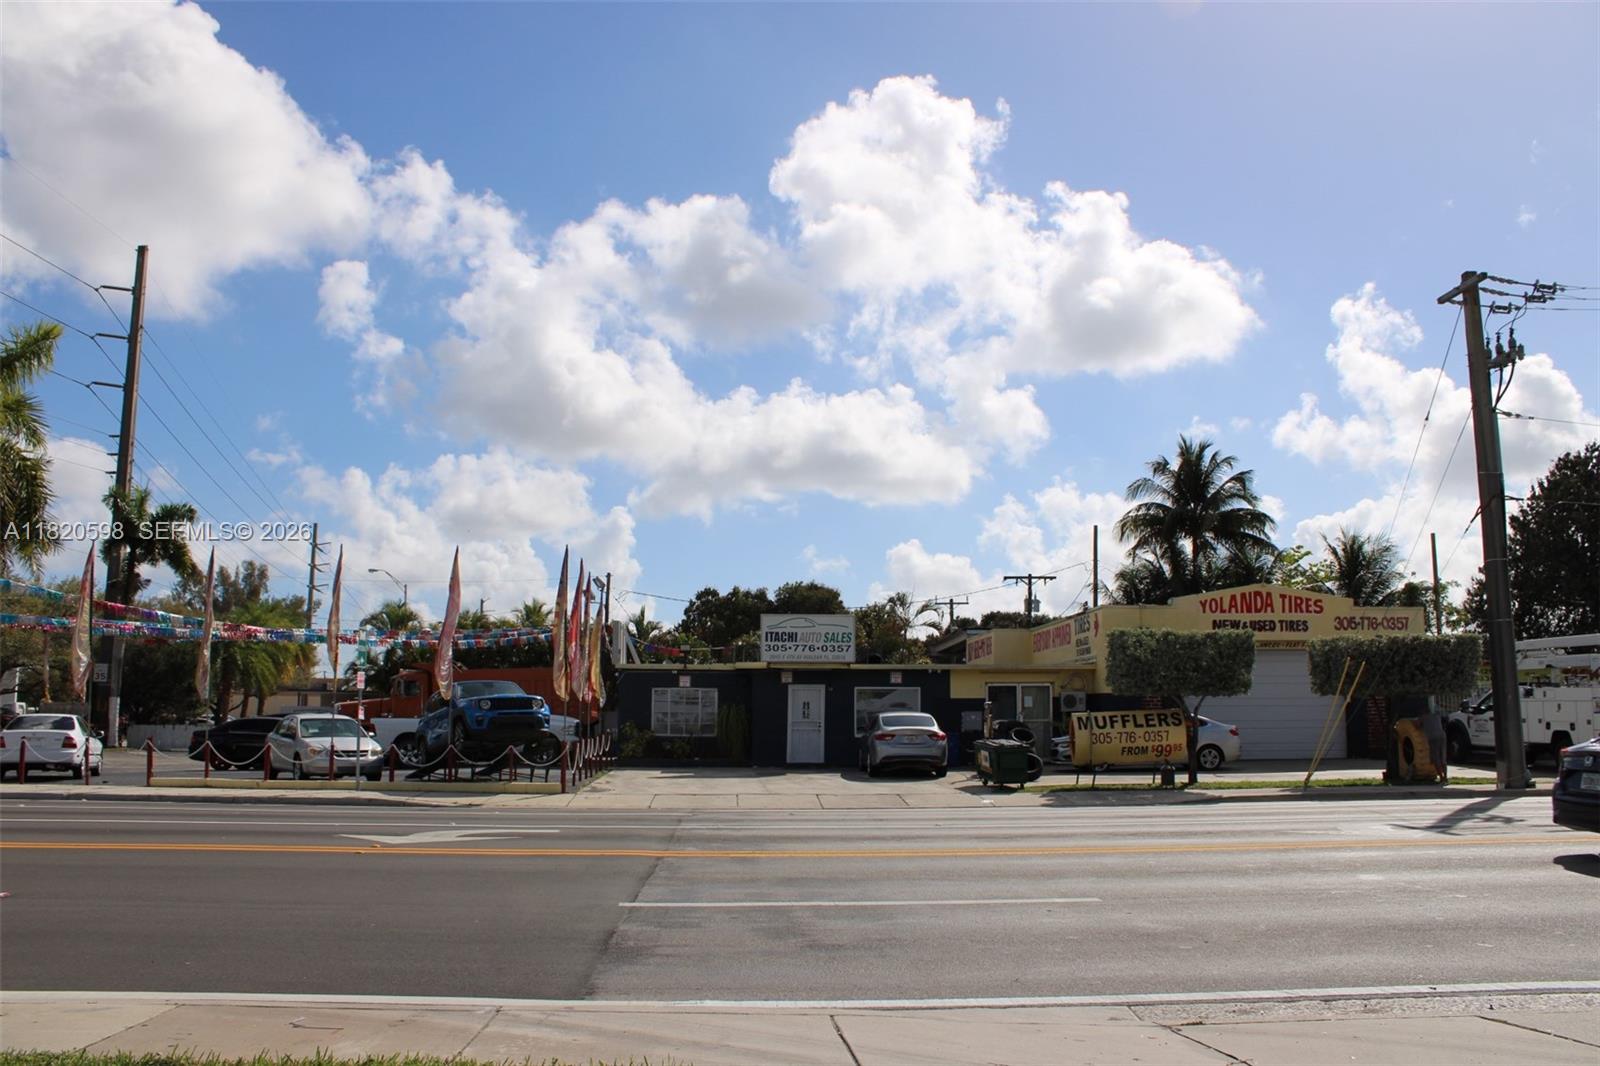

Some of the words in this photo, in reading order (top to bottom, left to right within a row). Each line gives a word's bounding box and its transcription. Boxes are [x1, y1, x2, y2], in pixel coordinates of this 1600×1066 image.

[1199, 591, 1275, 614] YOLANDA
[1279, 593, 1324, 614] TIRES
[1212, 619, 1241, 631] NEW
[1249, 619, 1276, 632] USED
[1278, 619, 1309, 632] TIRES
[1334, 616, 1410, 631] 305-776-0357
[765, 631, 798, 643] ITACHI
[800, 631, 822, 643] AUTO
[823, 631, 853, 644] SALES
[95, 672, 106, 680] 35
[1076, 711, 1183, 730] MUFFLERS
[1121, 745, 1149, 756] FROM
